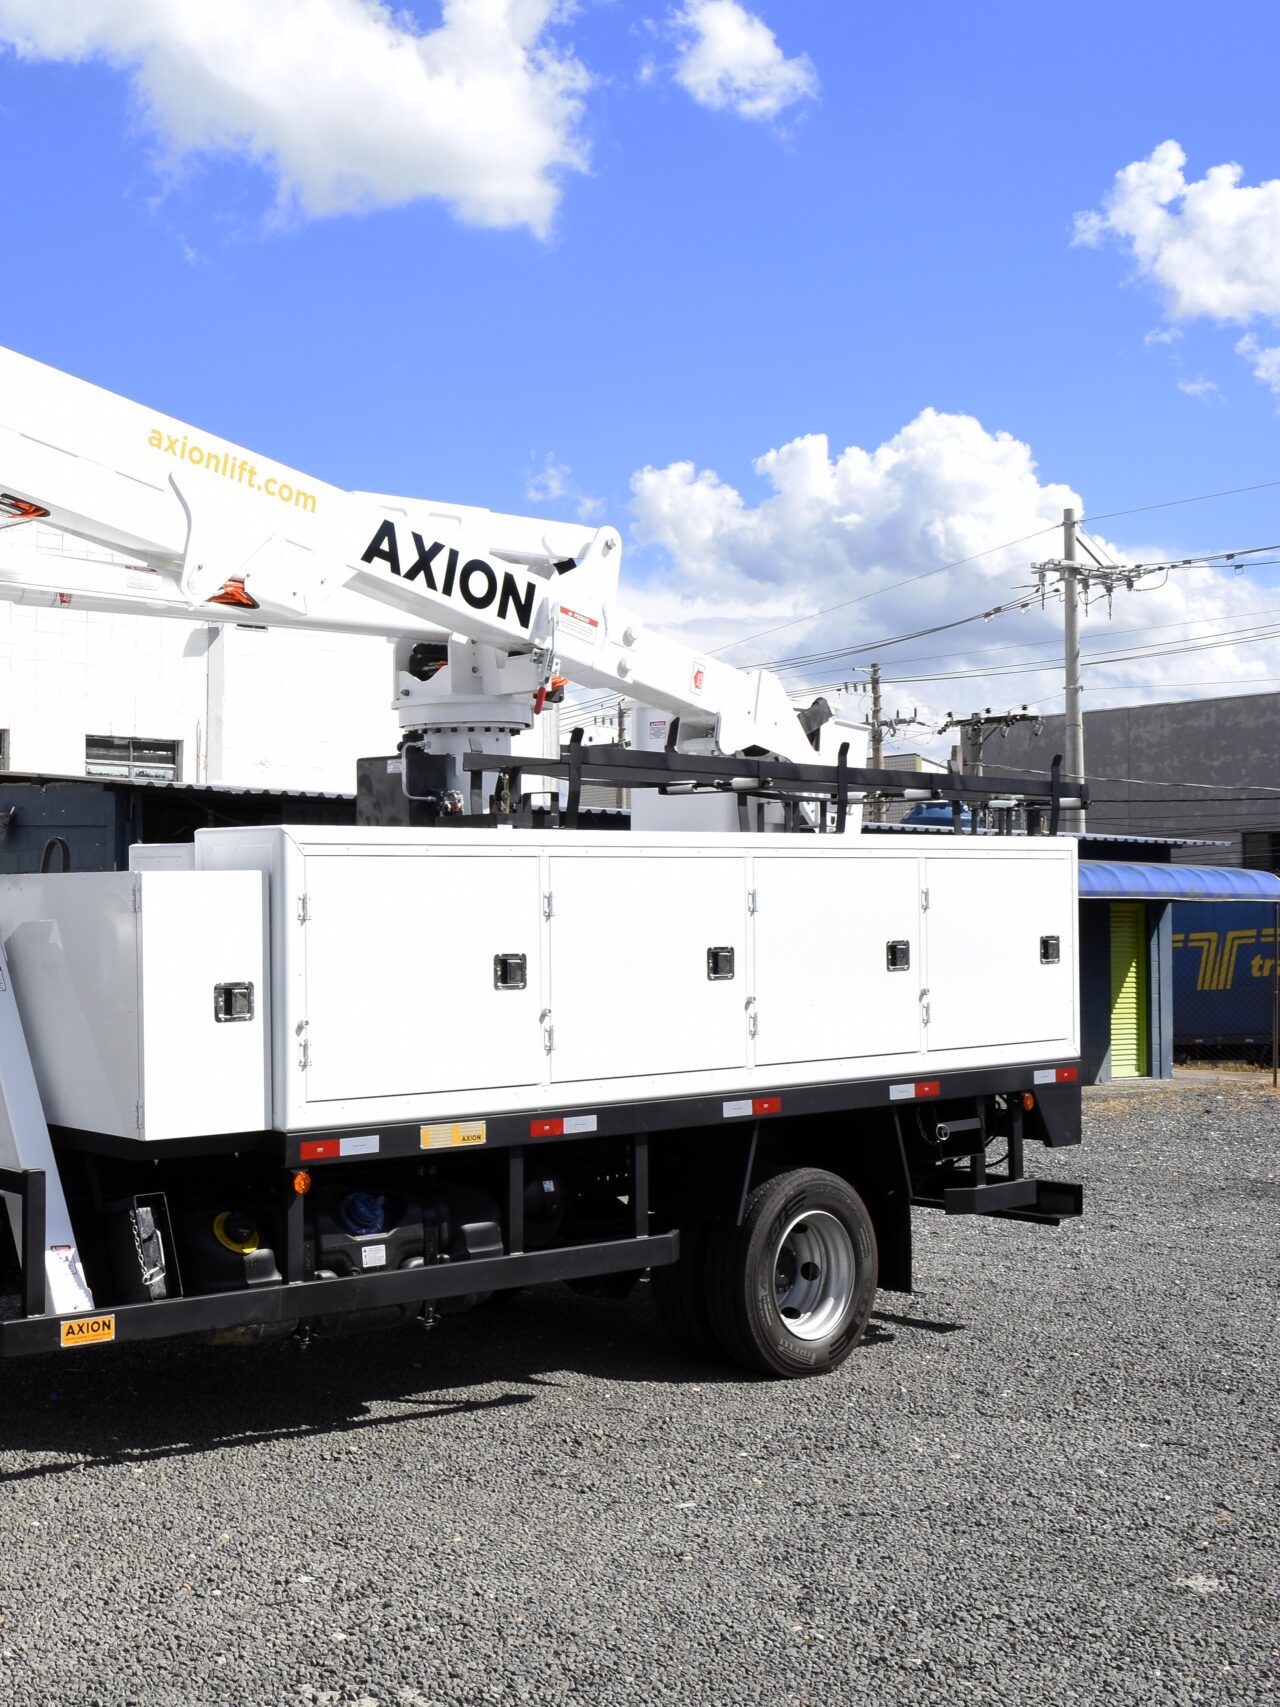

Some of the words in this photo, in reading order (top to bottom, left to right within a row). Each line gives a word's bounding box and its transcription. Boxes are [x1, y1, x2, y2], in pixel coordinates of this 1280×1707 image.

[148, 428, 317, 513] axionlift.com
[360, 519, 537, 630] AXION
[461, 1134, 482, 1142] AXION
[65, 1319, 111, 1337] AXION
